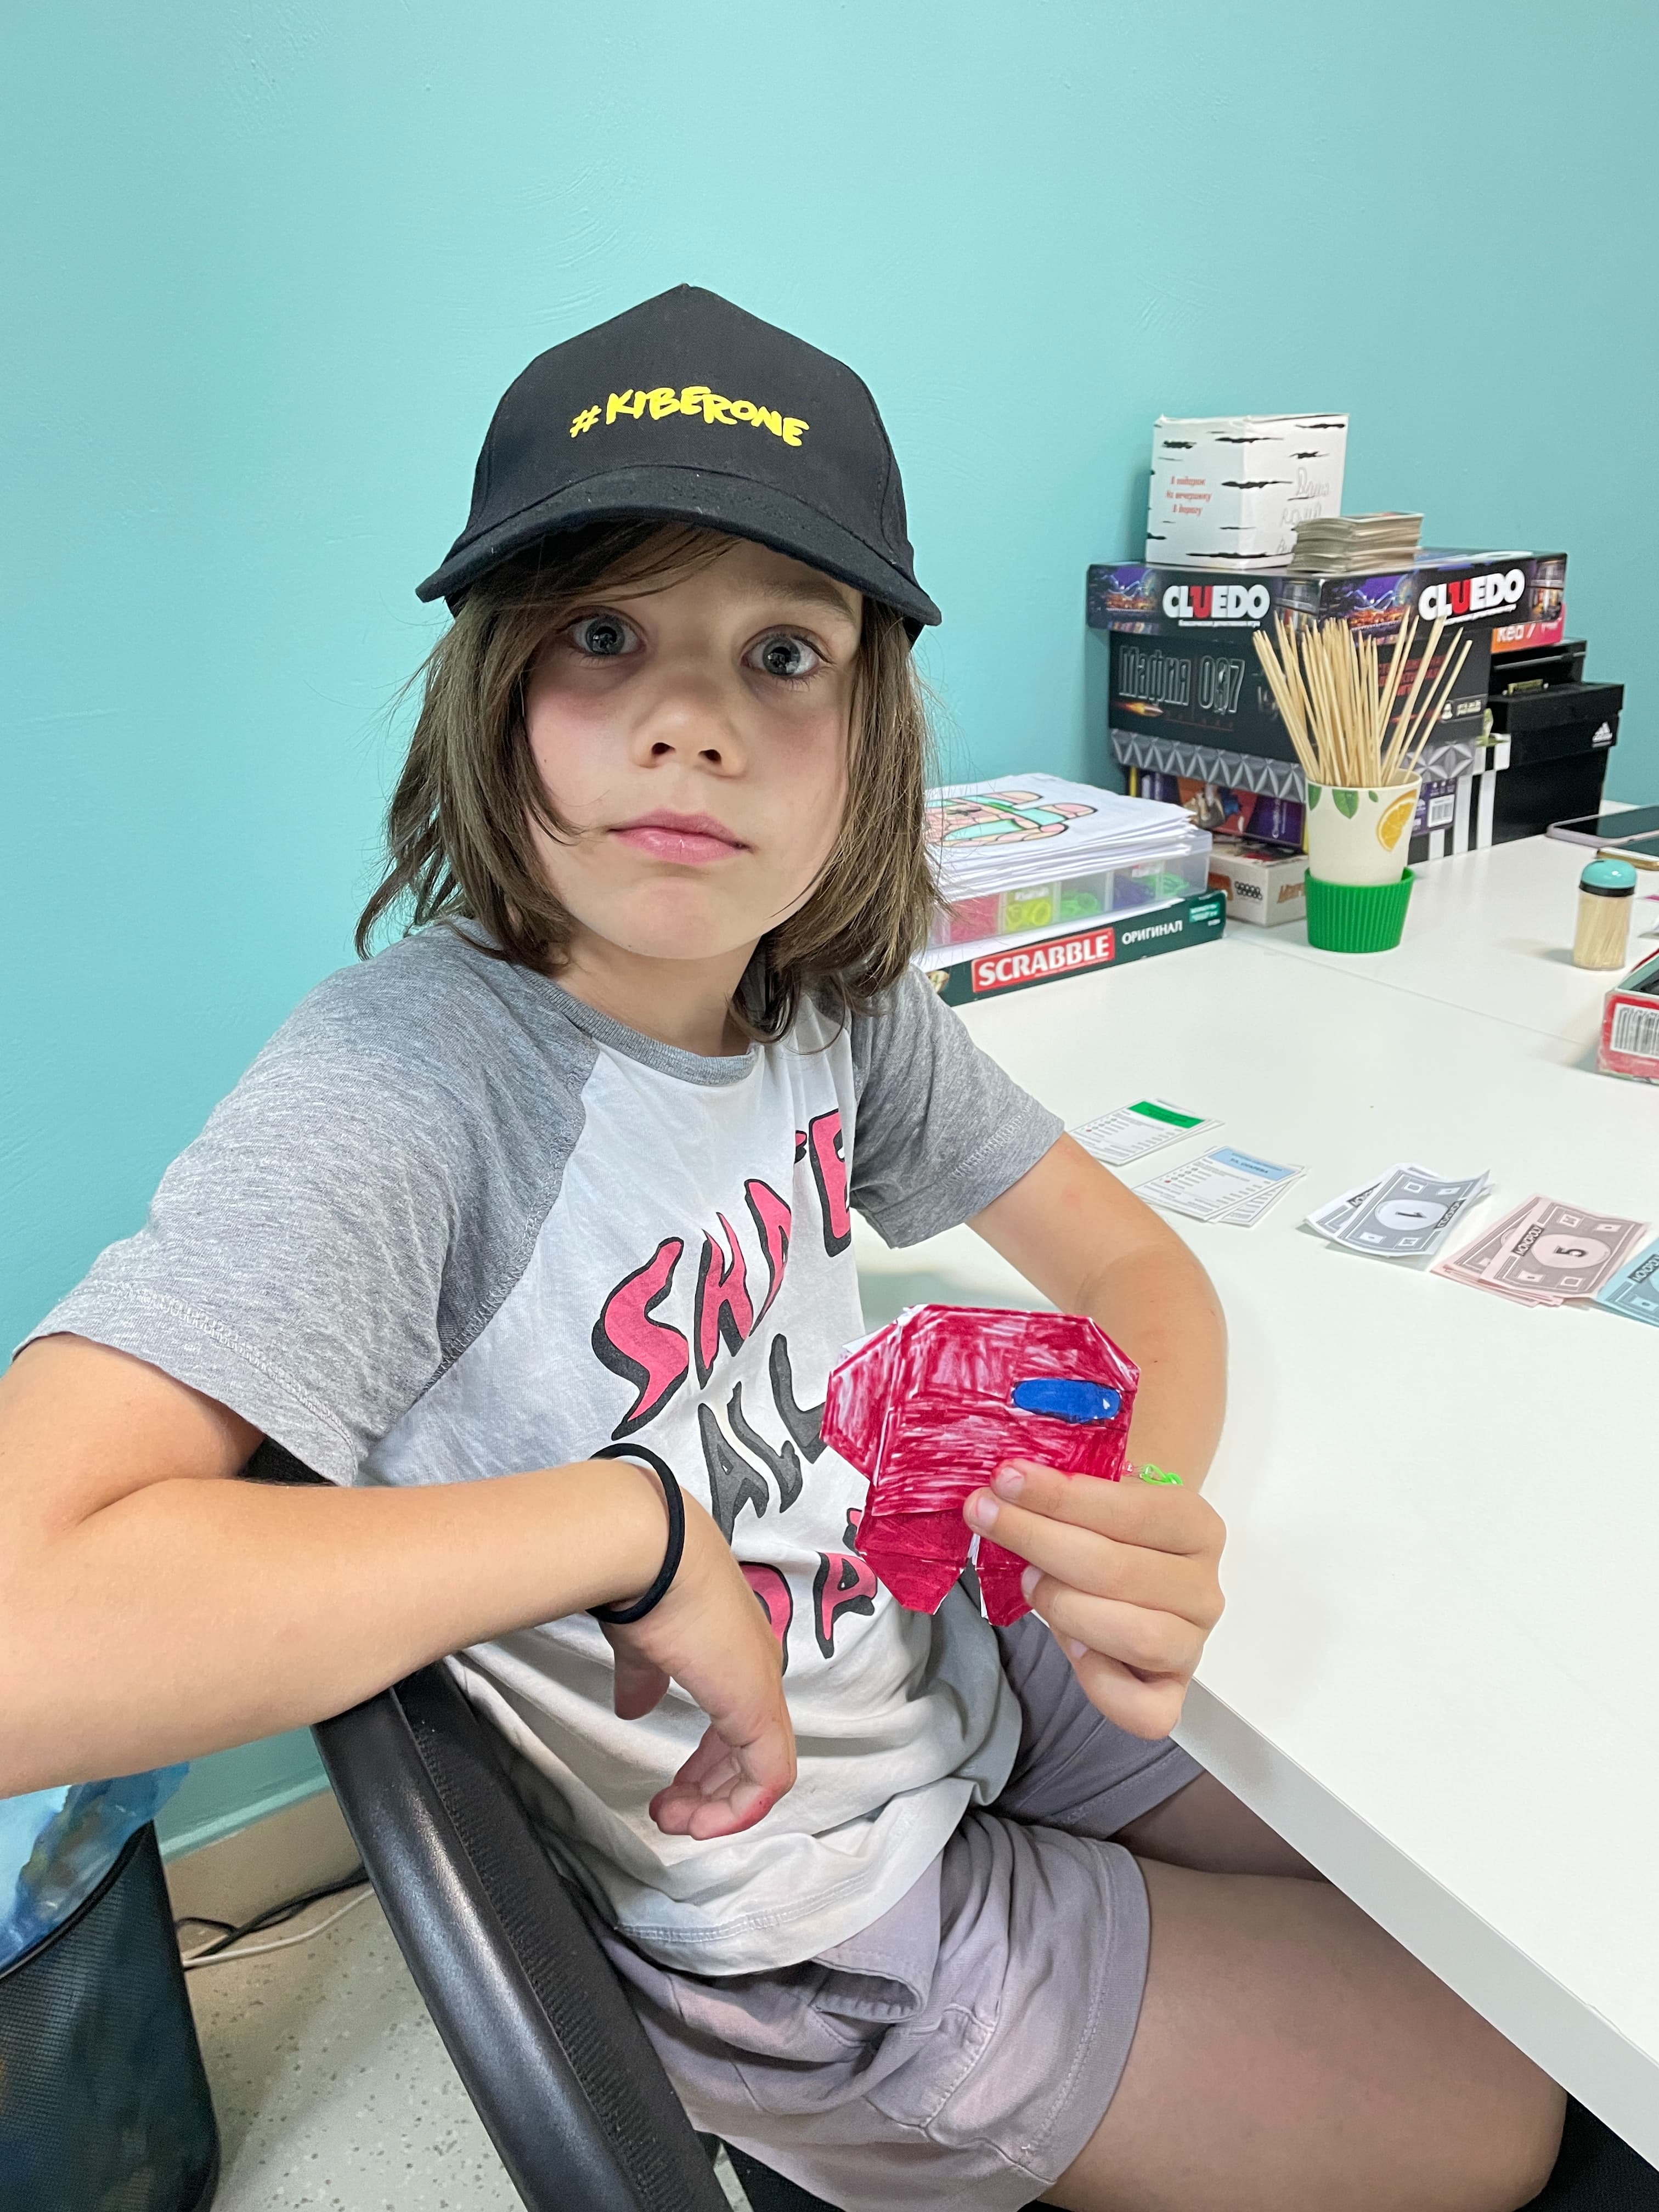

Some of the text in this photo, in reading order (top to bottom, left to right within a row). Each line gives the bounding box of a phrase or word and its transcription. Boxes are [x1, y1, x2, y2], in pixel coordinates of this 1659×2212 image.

[569, 386, 810, 447] #KIBERONE
[1163, 584, 1271, 619] CLUEDO
[1418, 568, 1525, 621] CLUEDO
[1121, 919, 1183, 945] ОРИГИНАЛ
[978, 934, 1110, 986] SCRABBLE
[1553, 1245, 1589, 1257] 5
